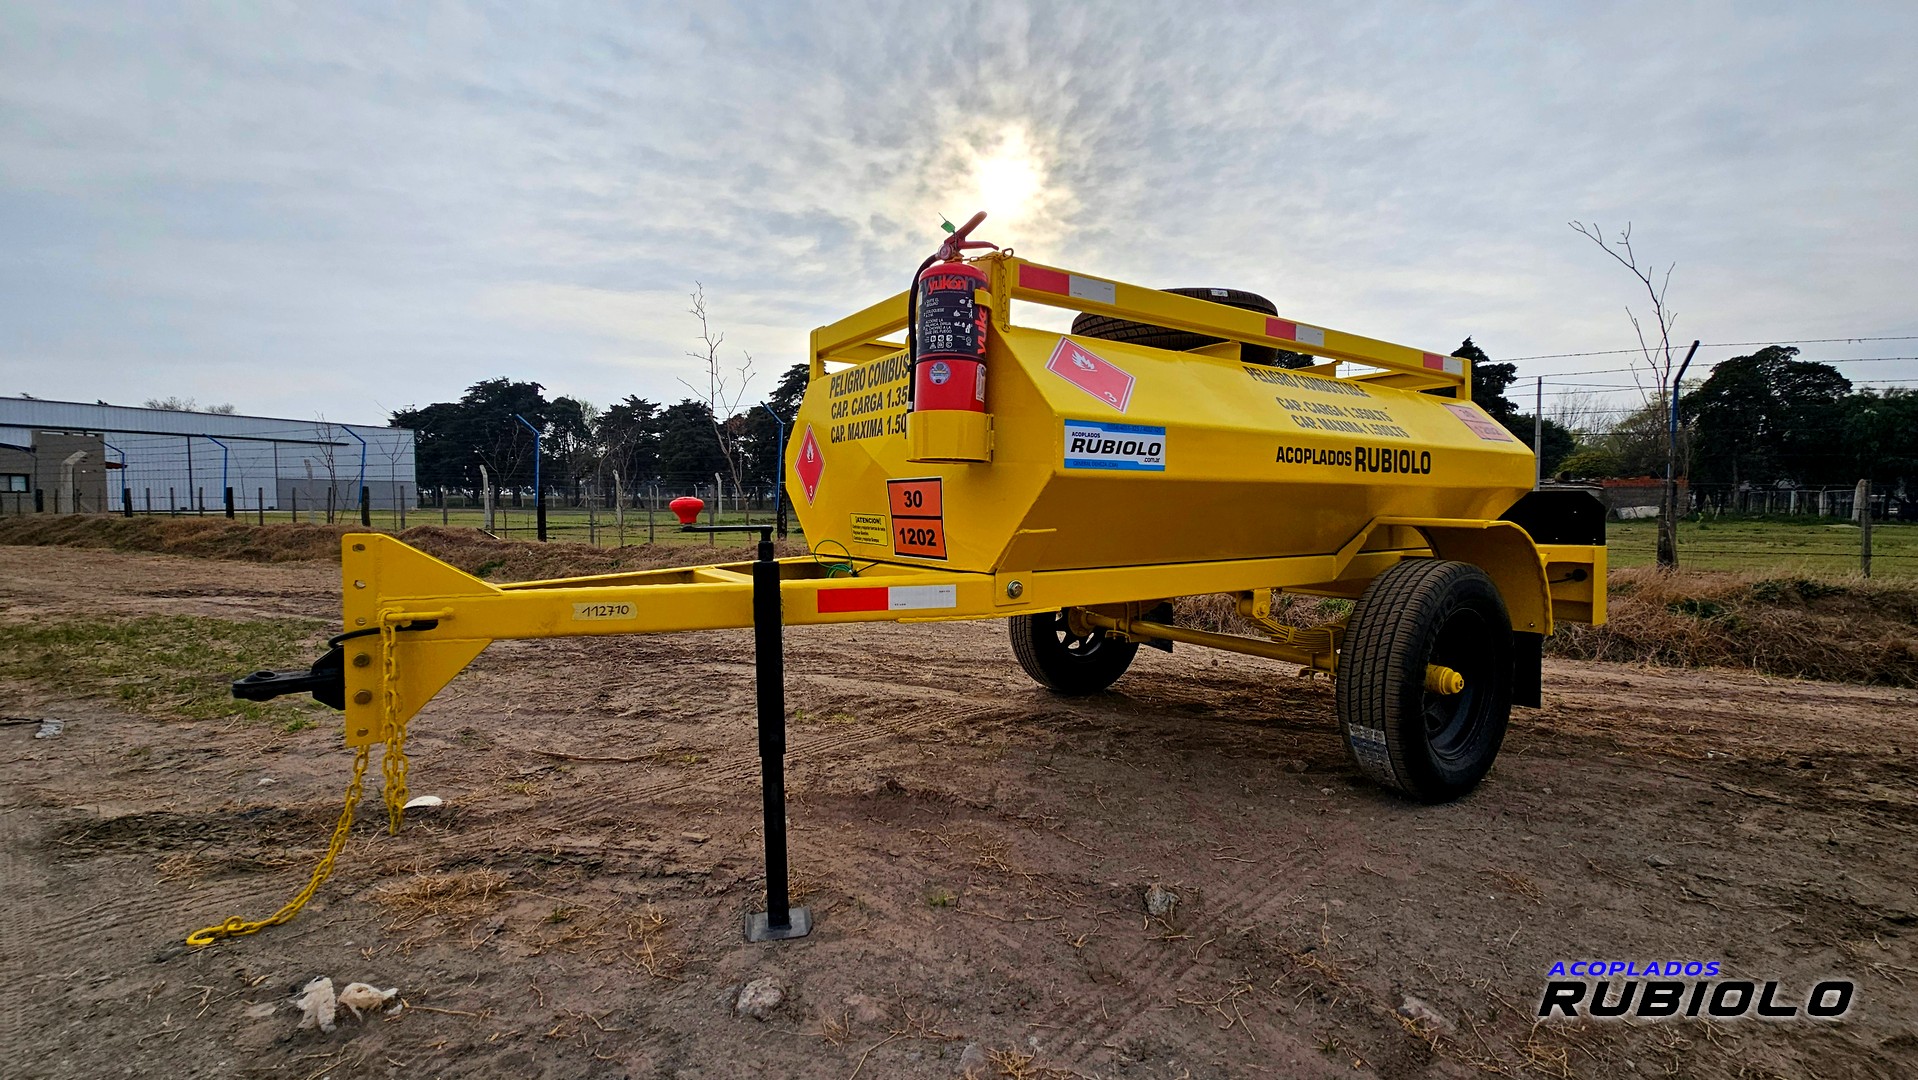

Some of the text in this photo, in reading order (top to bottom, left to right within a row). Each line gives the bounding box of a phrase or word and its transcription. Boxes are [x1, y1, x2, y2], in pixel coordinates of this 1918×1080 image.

[829, 367, 866, 399] PELIGRO
[1242, 365, 1371, 398] PELIGRO COMBUSTIBLE
[831, 384, 908, 420] CAP. CARGA 1.35
[1104, 391, 1117, 403] 3
[1275, 396, 1308, 413] CAP.
[1303, 401, 1347, 418] CARGA
[830, 424, 846, 444] CAP.
[848, 417, 883, 441] MAXIMA
[1291, 414, 1323, 430] CAP.
[1318, 417, 1365, 434] MAXIMA
[1071, 431, 1101, 439] ACOPLADOS
[1070, 438, 1162, 457] RUBIOLO
[1276, 446, 1431, 475] ACOPLADOS RUBIOLO
[809, 485, 814, 497] 3
[903, 490, 923, 508] 30
[899, 527, 937, 547] 1202
[581, 605, 630, 617] 112710
